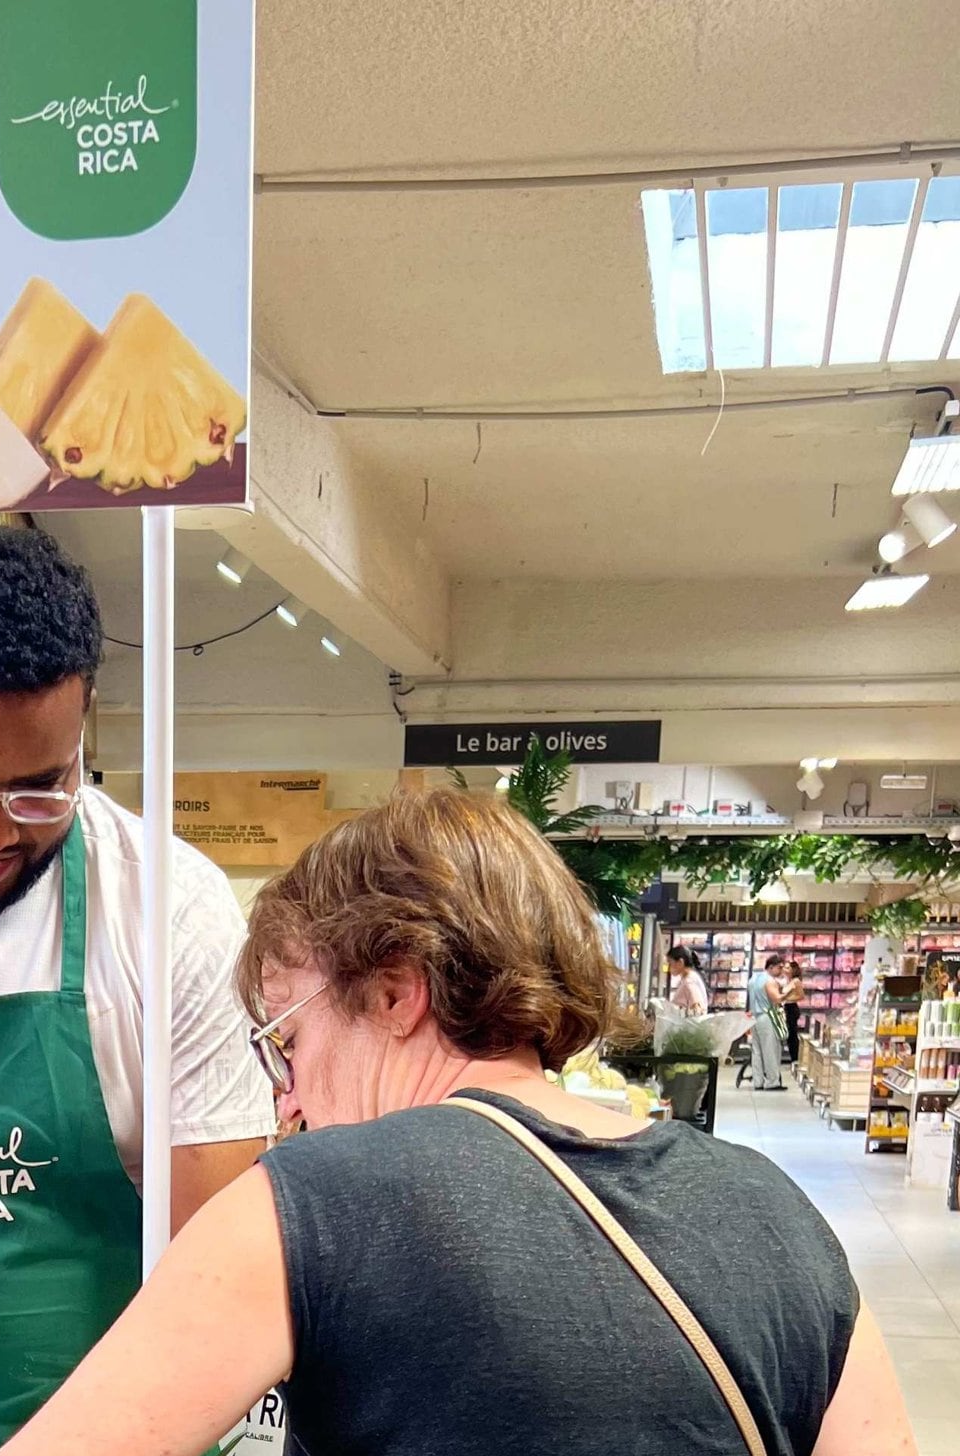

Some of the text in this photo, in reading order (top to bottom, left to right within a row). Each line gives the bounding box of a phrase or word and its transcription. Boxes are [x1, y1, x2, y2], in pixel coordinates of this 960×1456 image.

[11, 74, 171, 130] essential
[76, 119, 160, 149] COSTA
[78, 147, 139, 176] RICA
[456, 733, 480, 753] Le
[486, 732, 522, 752] bar
[545, 730, 607, 751] olives
[260, 778, 321, 791] Intermarché
[245, 1431, 274, 1443] CALIBRE
